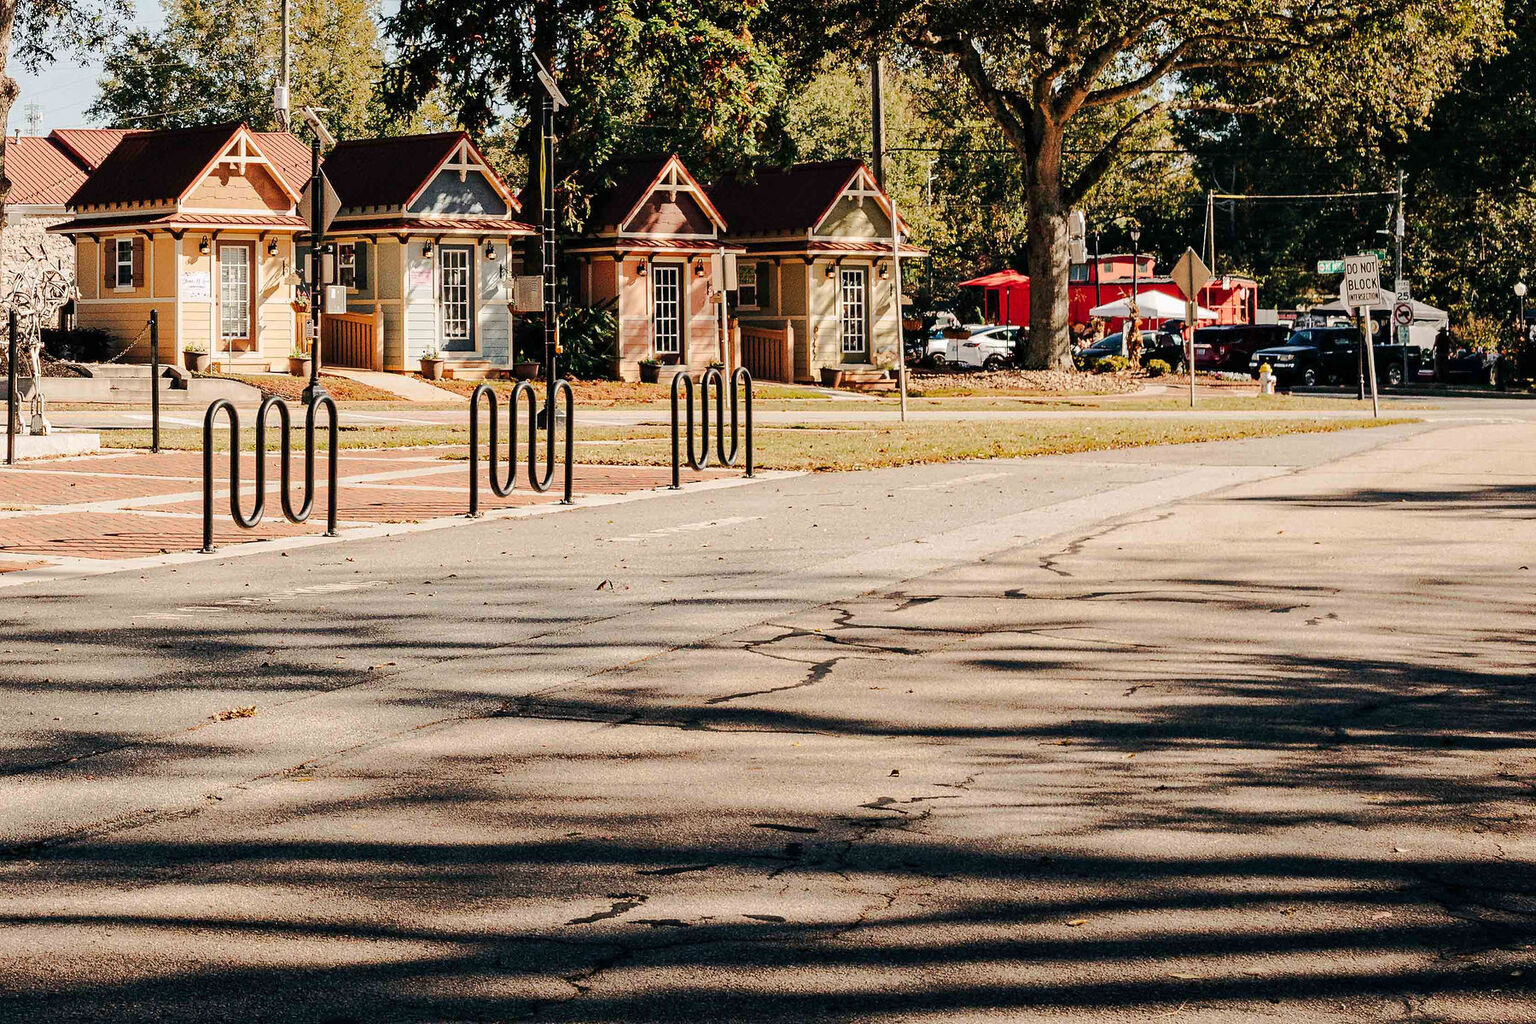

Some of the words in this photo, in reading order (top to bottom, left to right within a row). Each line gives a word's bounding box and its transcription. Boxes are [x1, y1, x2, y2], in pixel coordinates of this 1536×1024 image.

[1347, 263, 1358, 275] DO
[1360, 261, 1375, 273] NOT
[1348, 278, 1377, 290] BLOCK
[1397, 291, 1409, 300] 25
